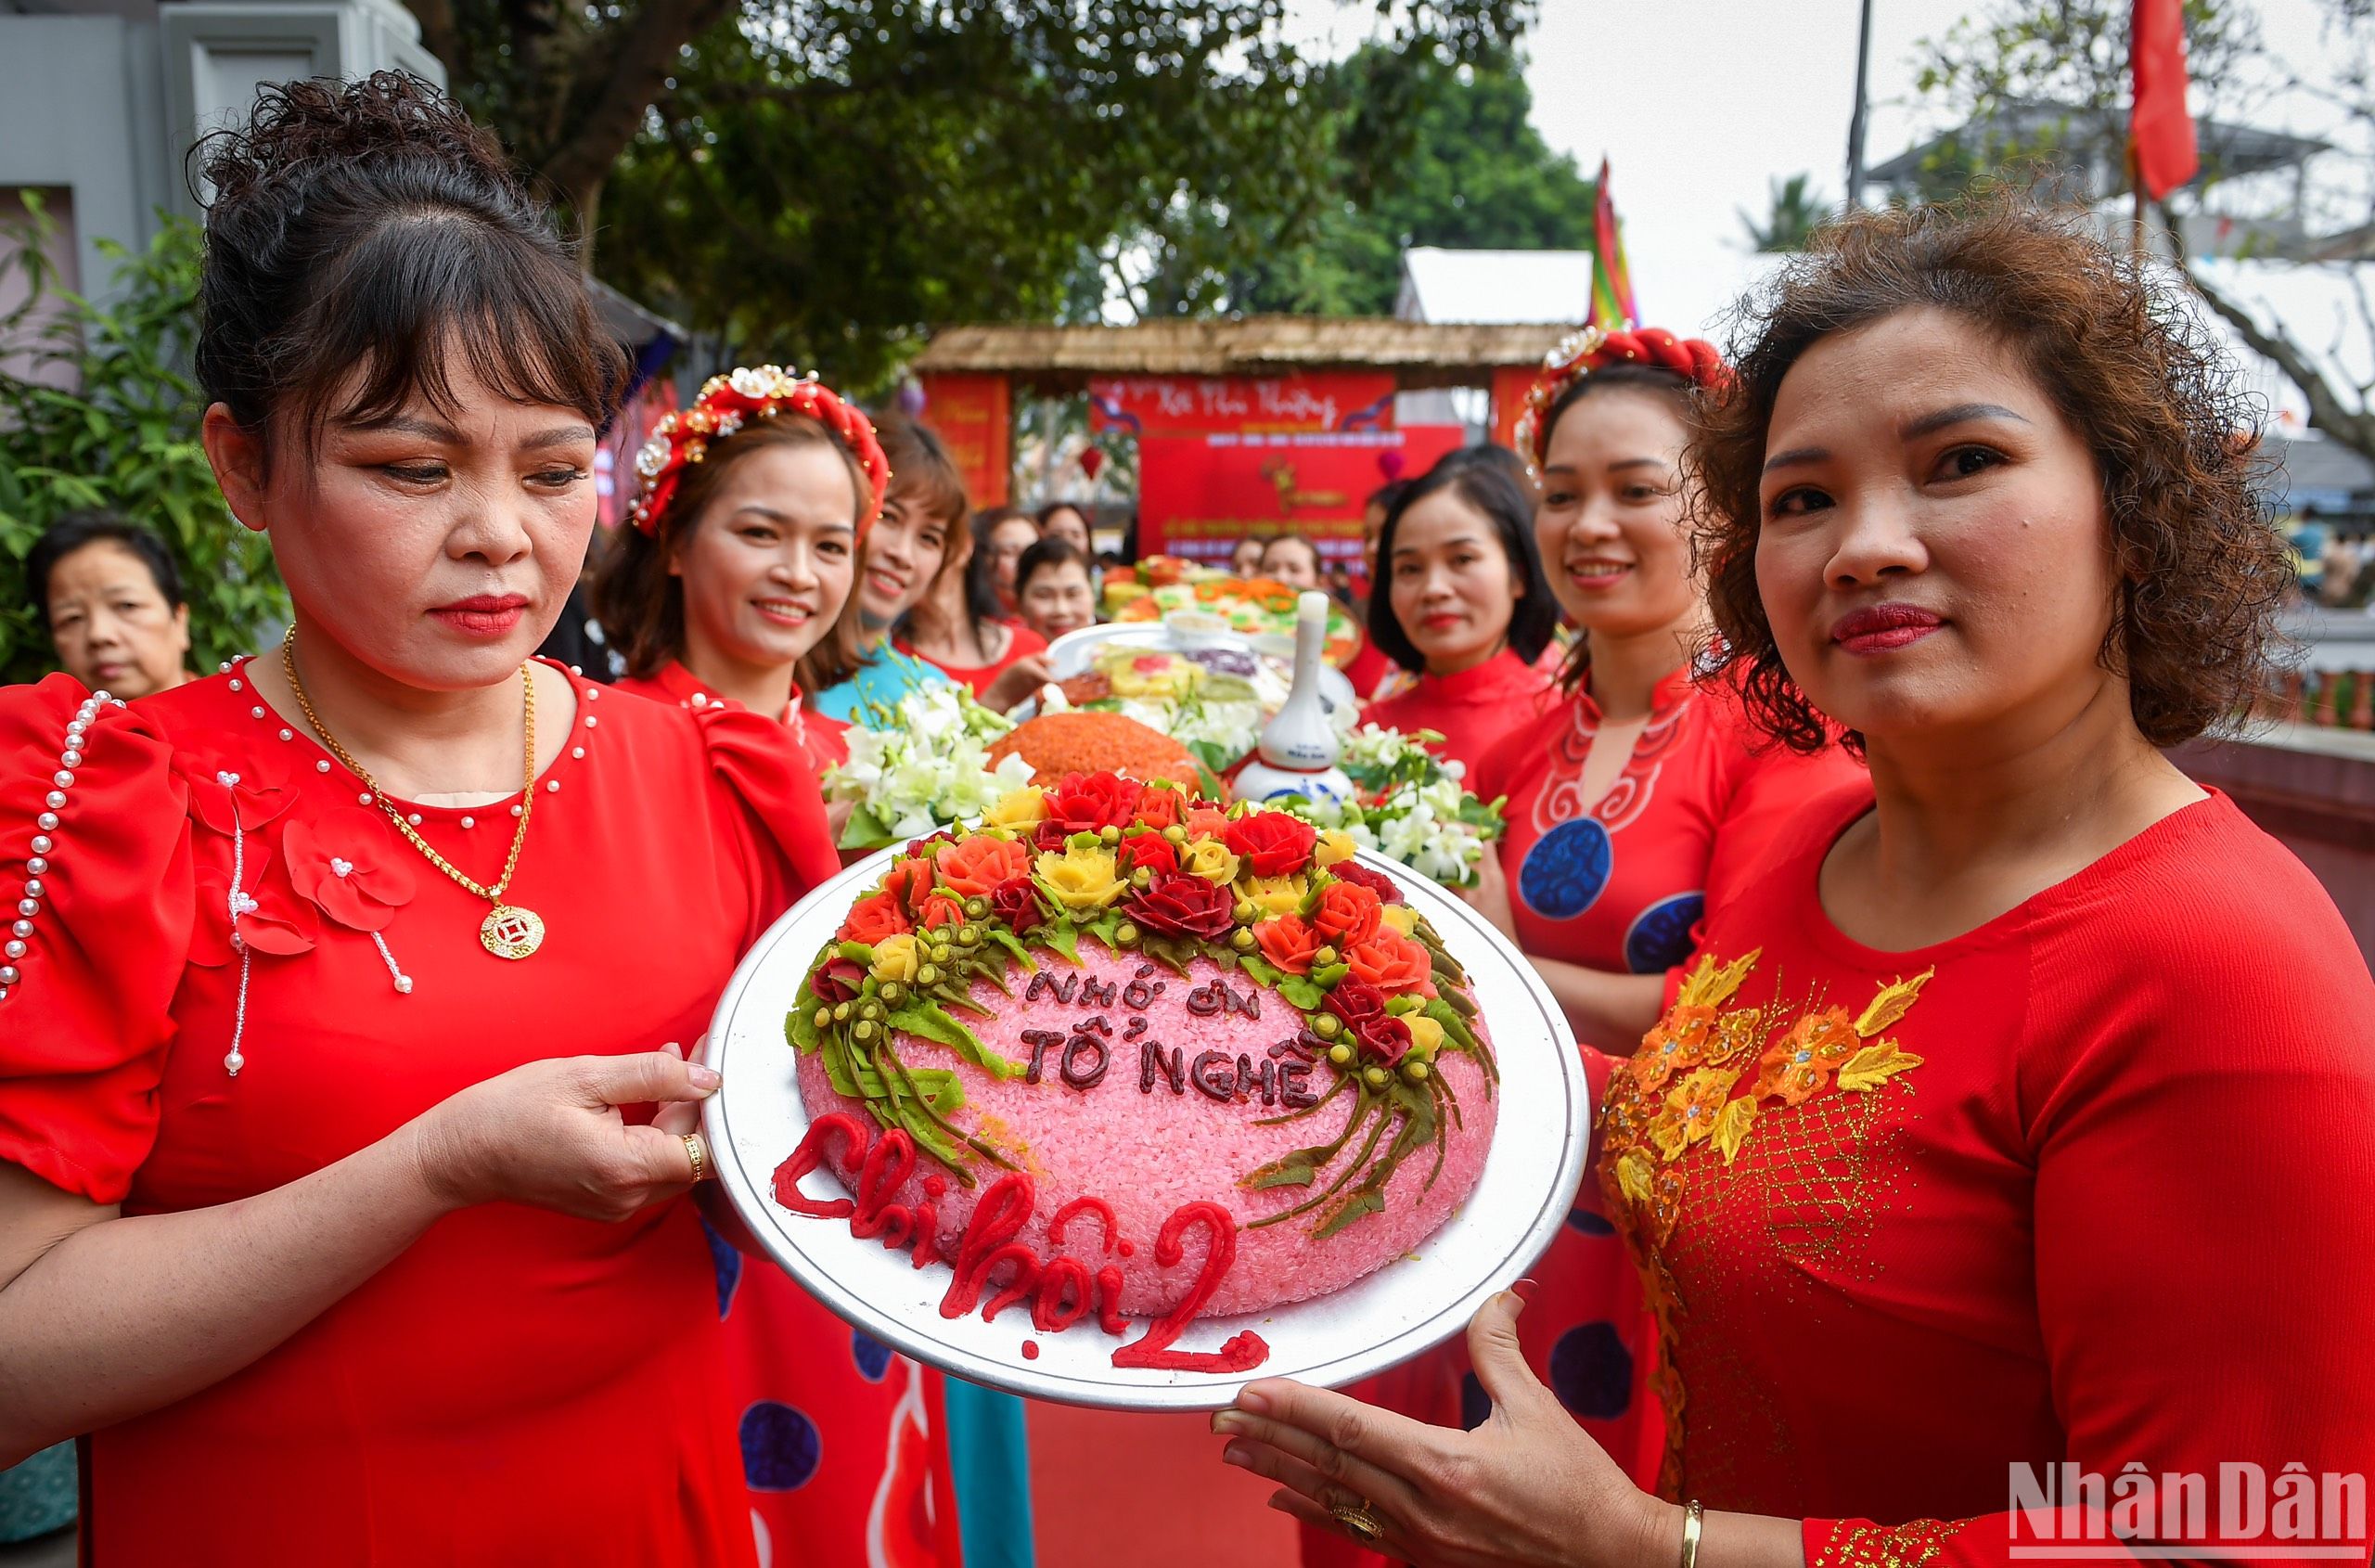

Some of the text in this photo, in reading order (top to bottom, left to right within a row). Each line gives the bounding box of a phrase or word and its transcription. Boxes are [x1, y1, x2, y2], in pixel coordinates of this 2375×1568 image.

[1026, 964, 1261, 1021] NHỚ ƠN
[1021, 1016, 1335, 1109] TỔ NGHỀ
[770, 1113, 945, 1269] Chi
[1111, 1201, 1269, 1373] 2
